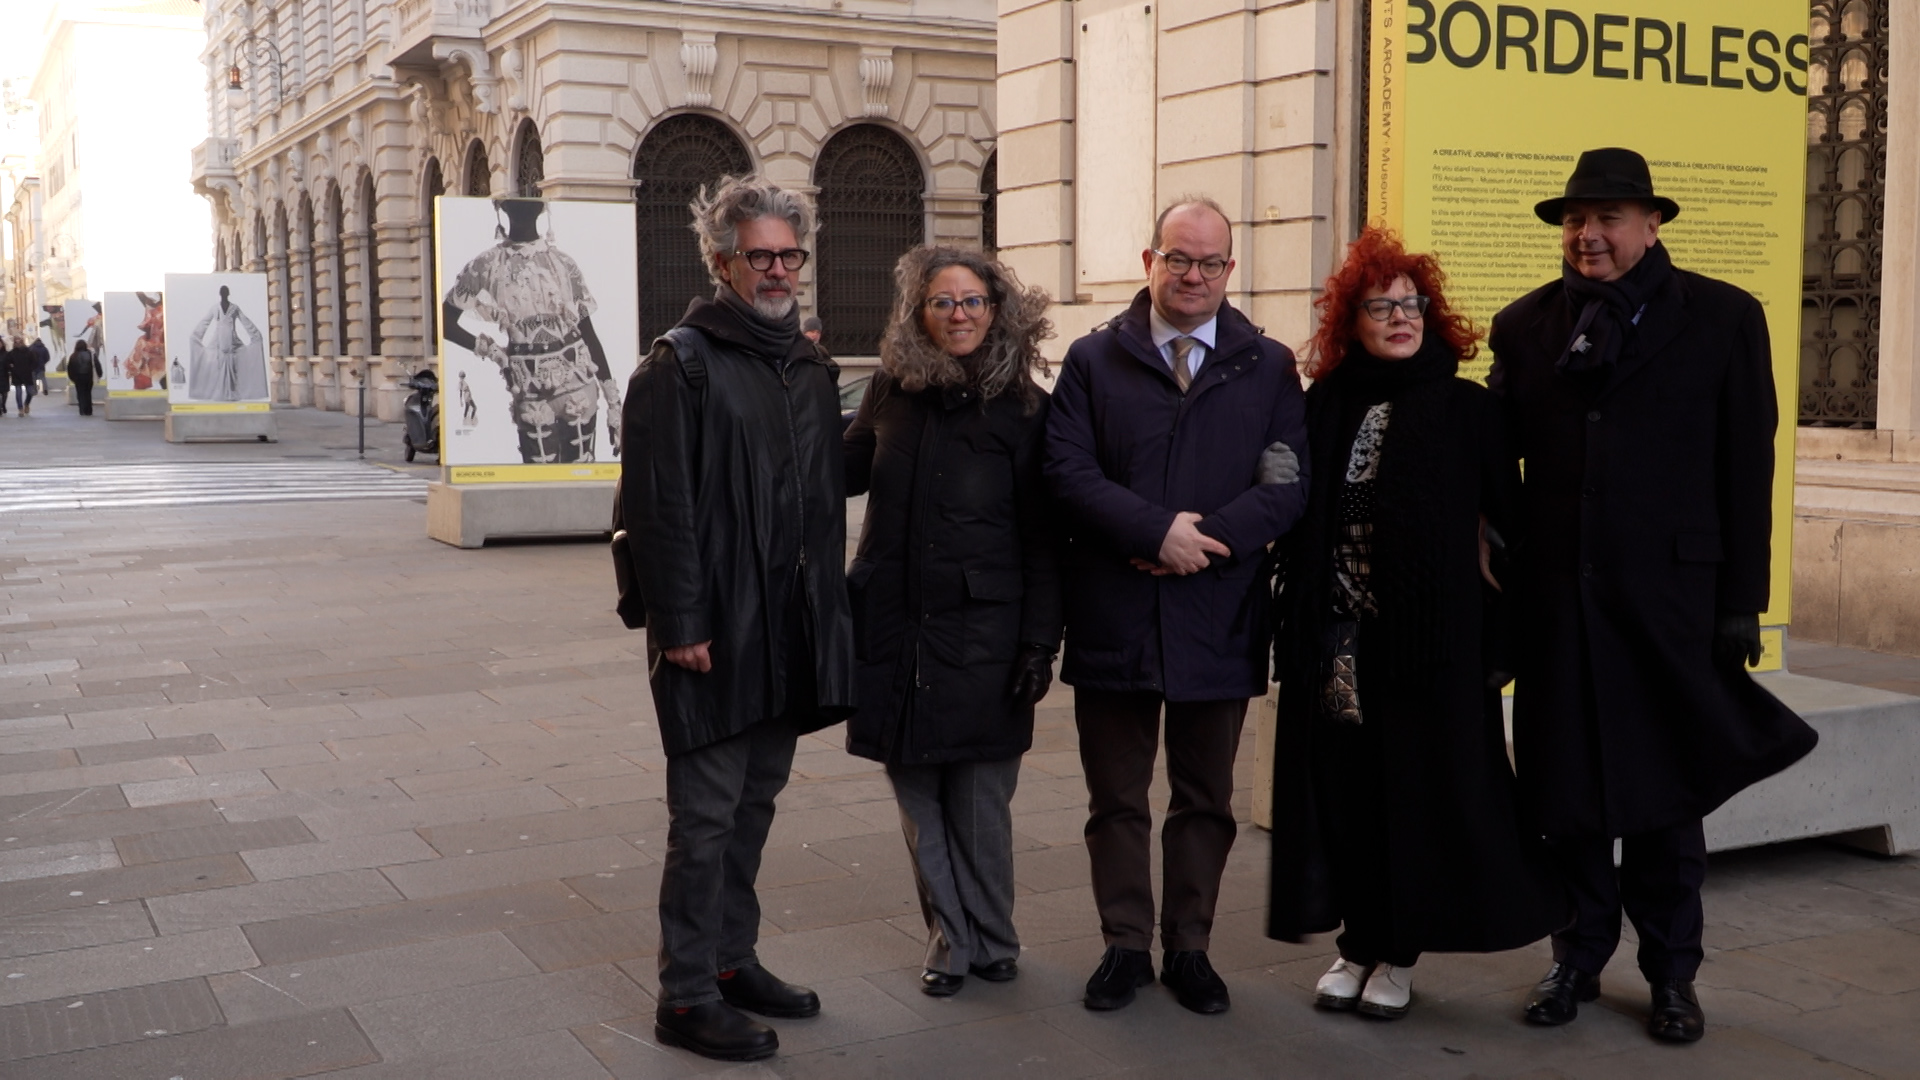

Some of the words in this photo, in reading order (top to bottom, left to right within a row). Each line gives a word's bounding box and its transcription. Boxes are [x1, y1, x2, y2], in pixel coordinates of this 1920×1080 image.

[1407, 0, 1808, 97] BORDERLESS
[1381, 37, 1392, 139] ARCADEMY
[1439, 149, 1472, 158] CREATIVE
[1380, 147, 1390, 216] Museum
[1480, 176, 1505, 184] Museum
[1432, 196, 1460, 204] emerging
[1460, 196, 1489, 204] designers
[1726, 198, 1748, 206] designer
[1449, 230, 1473, 238] regional
[1474, 231, 1499, 239] authority
[1712, 230, 1732, 238] Regione
[1522, 242, 1552, 250] Borderless
[1453, 250, 1482, 258] European
